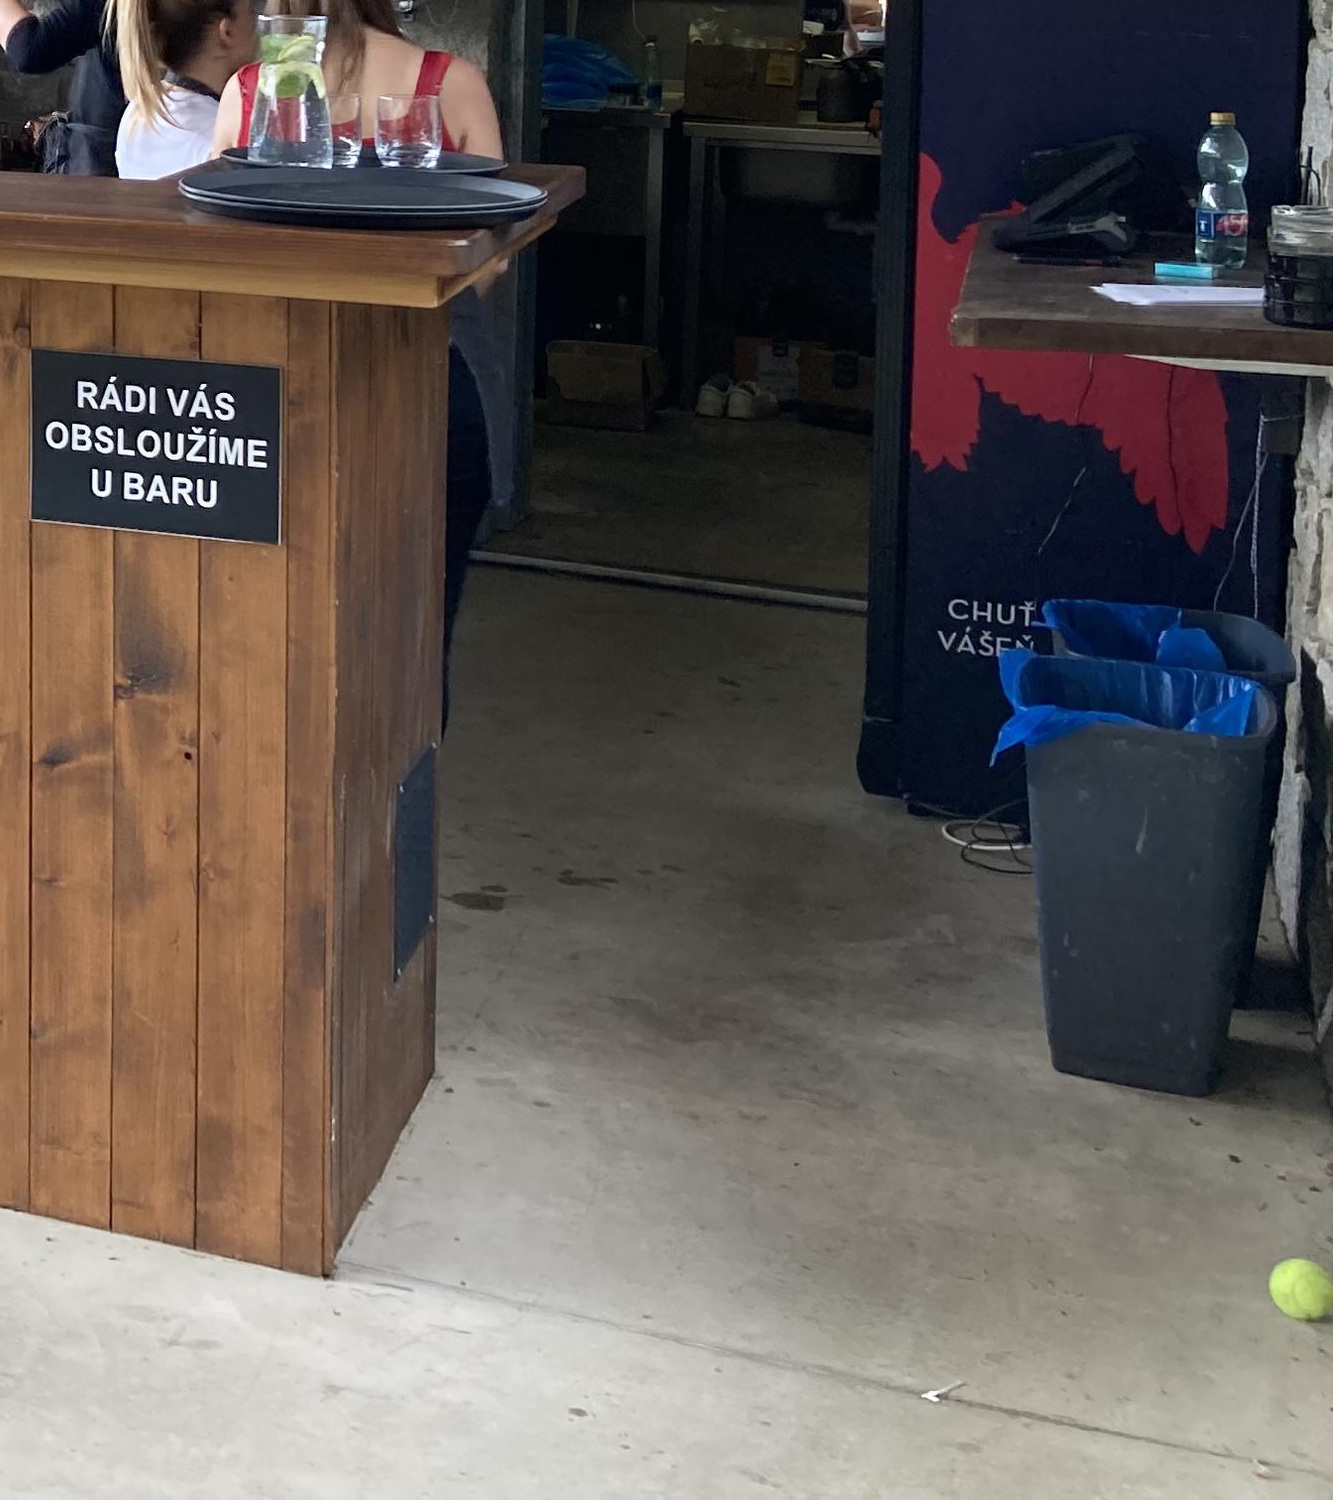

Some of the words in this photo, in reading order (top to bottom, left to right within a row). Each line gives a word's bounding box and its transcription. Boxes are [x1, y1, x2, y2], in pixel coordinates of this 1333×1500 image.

[76, 376, 157, 415] RÁDI
[166, 384, 236, 421] VÁS
[45, 420, 268, 469] OBSLOUŽÍME
[91, 468, 113, 498] U
[123, 472, 219, 509] BARU
[947, 598, 1037, 628] CHUŤ
